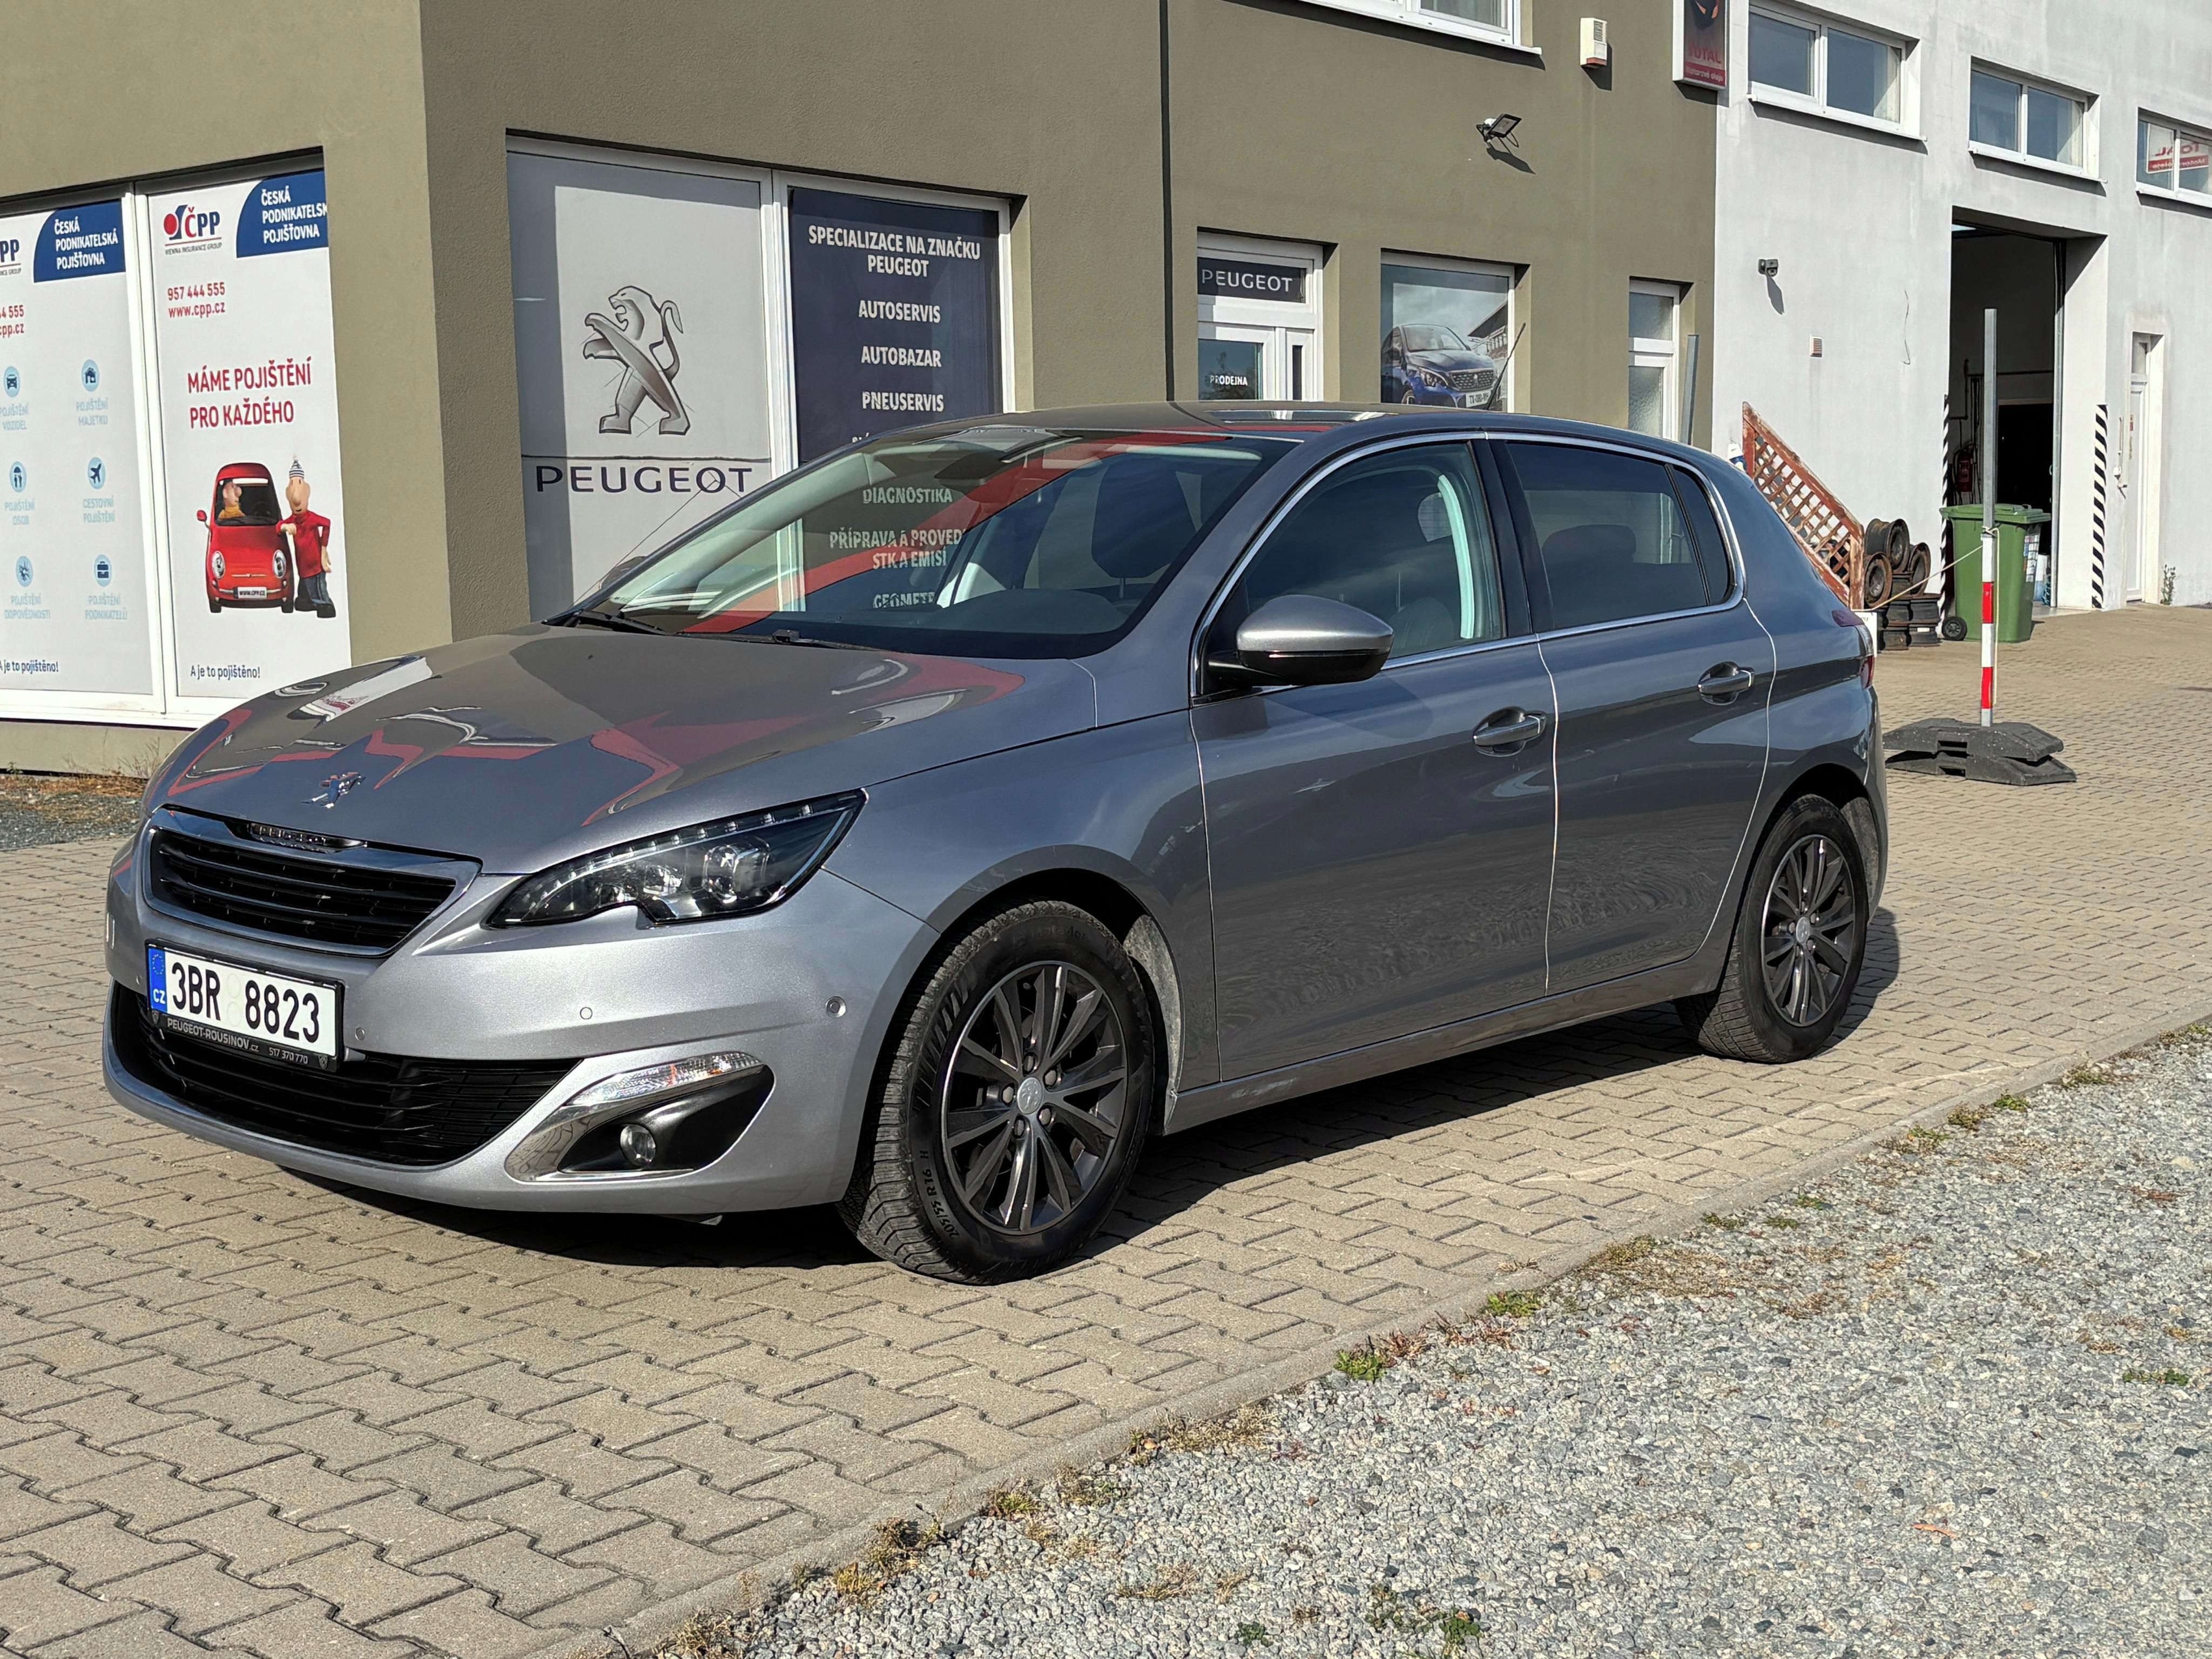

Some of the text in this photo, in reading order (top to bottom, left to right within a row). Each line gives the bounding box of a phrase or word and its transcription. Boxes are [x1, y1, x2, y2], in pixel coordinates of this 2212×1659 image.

[261, 185, 291, 206] ČESKÁ
[185, 206, 220, 238] ČPP
[262, 203, 327, 224] PODNIKATELSK
[55, 216, 80, 235] ČESKÁ
[264, 224, 320, 244] POJIŠŤOVNA
[56, 228, 118, 252] PODNIKATELSKÁ
[165, 242, 222, 255] VIENNA INSURANCE GROUP
[808, 225, 980, 260] SPECIALIZACE NA ZNAČKU
[57, 252, 105, 270] POJIŠŤOVNA
[867, 254, 929, 277] PEUGEOT
[167, 281, 225, 301] 957 444 555
[1202, 269, 1292, 292] PEUGEOT
[9, 305, 24, 318] 555
[168, 302, 225, 318] www.cpp.cz
[859, 300, 941, 323] AUTOSERVIS
[861, 346, 942, 367] AUTOBAZAR
[188, 356, 312, 394] MÁME POJIŠTĚNÍ
[1210, 375, 1248, 386] PRODEJNA
[862, 391, 944, 412] PNEUSERVIS
[190, 396, 294, 429] PRO KAŽDÉHO
[536, 466, 752, 494] PEUGEOT
[862, 487, 953, 504] DIAGNOSTIKA
[829, 527, 966, 549] PŘÍPRAVA A PROVED
[873, 546, 946, 569] STK A EMISÍ
[4, 659, 10, 674] je
[12, 661, 20, 671] to
[21, 659, 59, 675] pojištěno!
[190, 664, 260, 680] A je to pojištěno!
[153, 989, 166, 1004] CZ
[172, 962, 319, 1043] 3BR 8823
[269, 1047, 280, 1059] 517
[282, 1050, 294, 1062] 370
[295, 1053, 308, 1064] 770
[931, 1200, 960, 1239] 205/55
